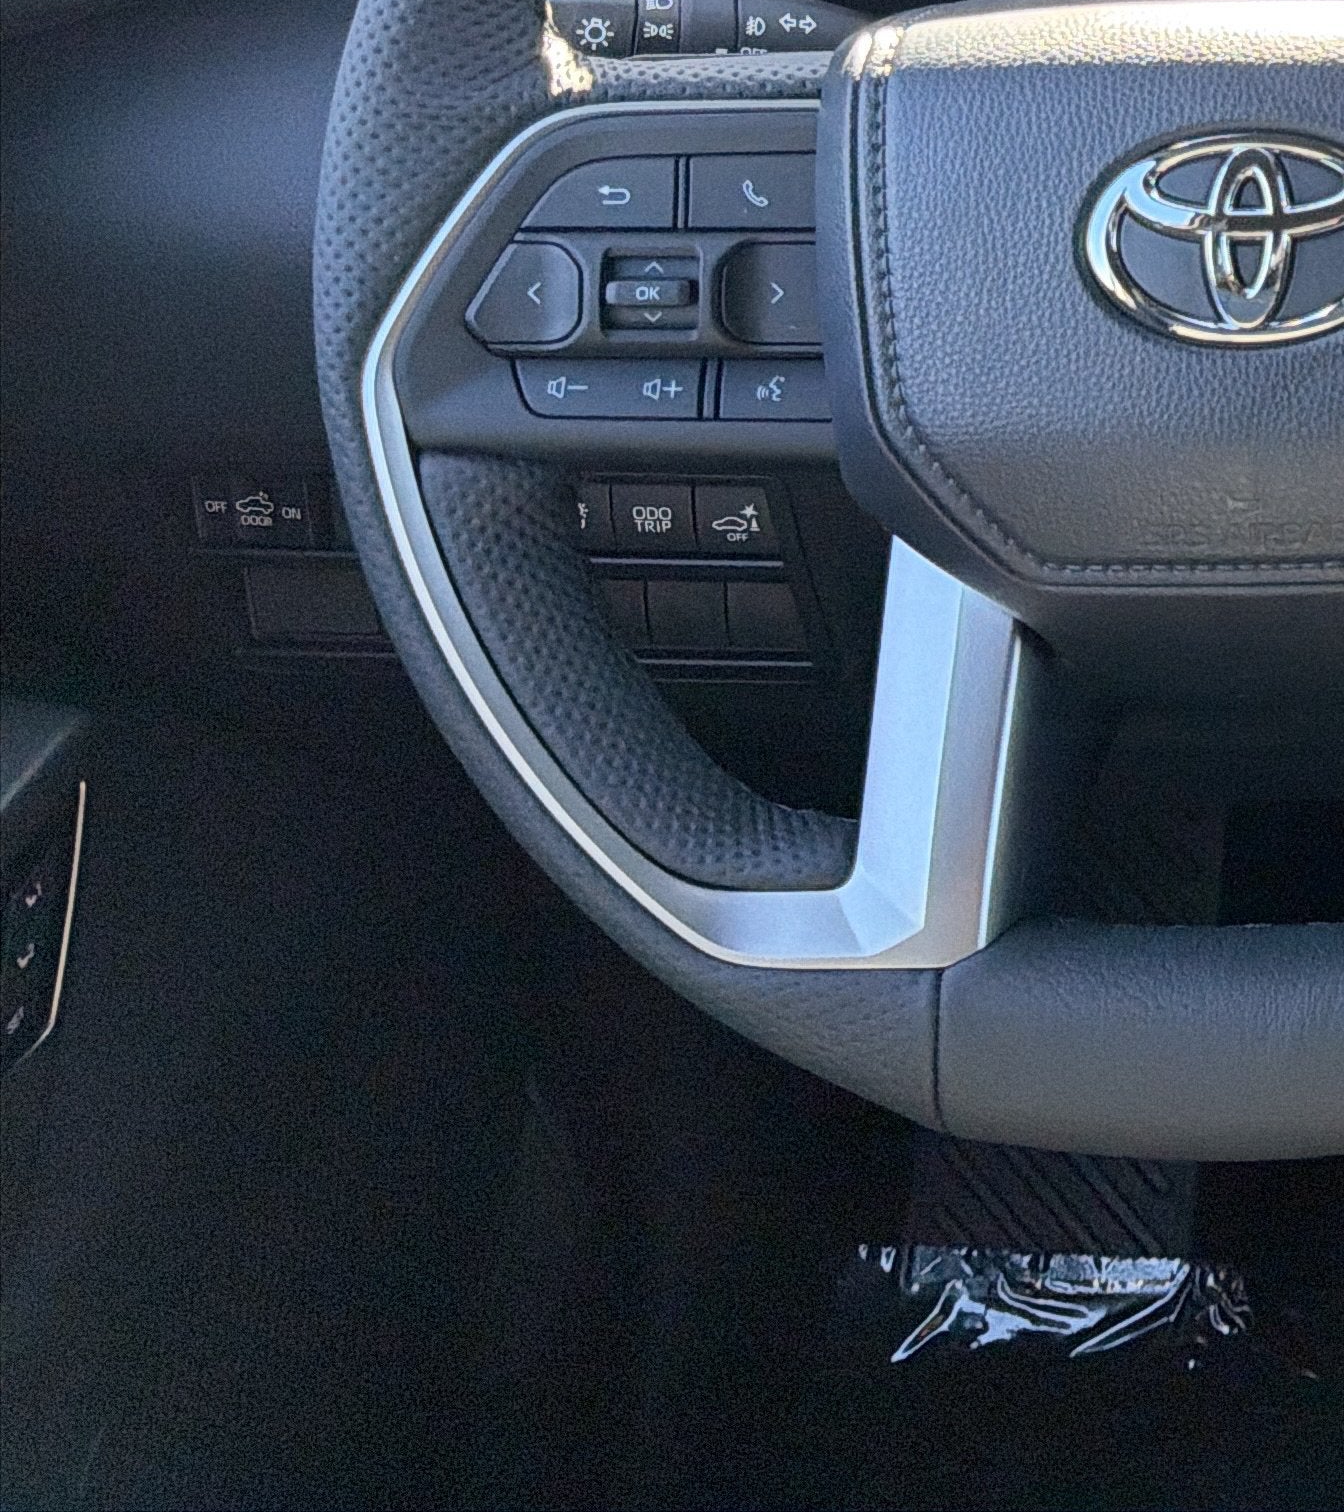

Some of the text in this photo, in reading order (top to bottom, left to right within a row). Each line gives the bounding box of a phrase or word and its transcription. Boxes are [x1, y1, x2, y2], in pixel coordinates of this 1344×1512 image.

[635, 285, 661, 301] OK
[204, 500, 228, 514] OFF
[281, 506, 302, 521] ON
[632, 506, 673, 521] ODO
[240, 514, 273, 527] DOOR
[634, 519, 673, 533] TRIP
[726, 532, 748, 542] OFF
